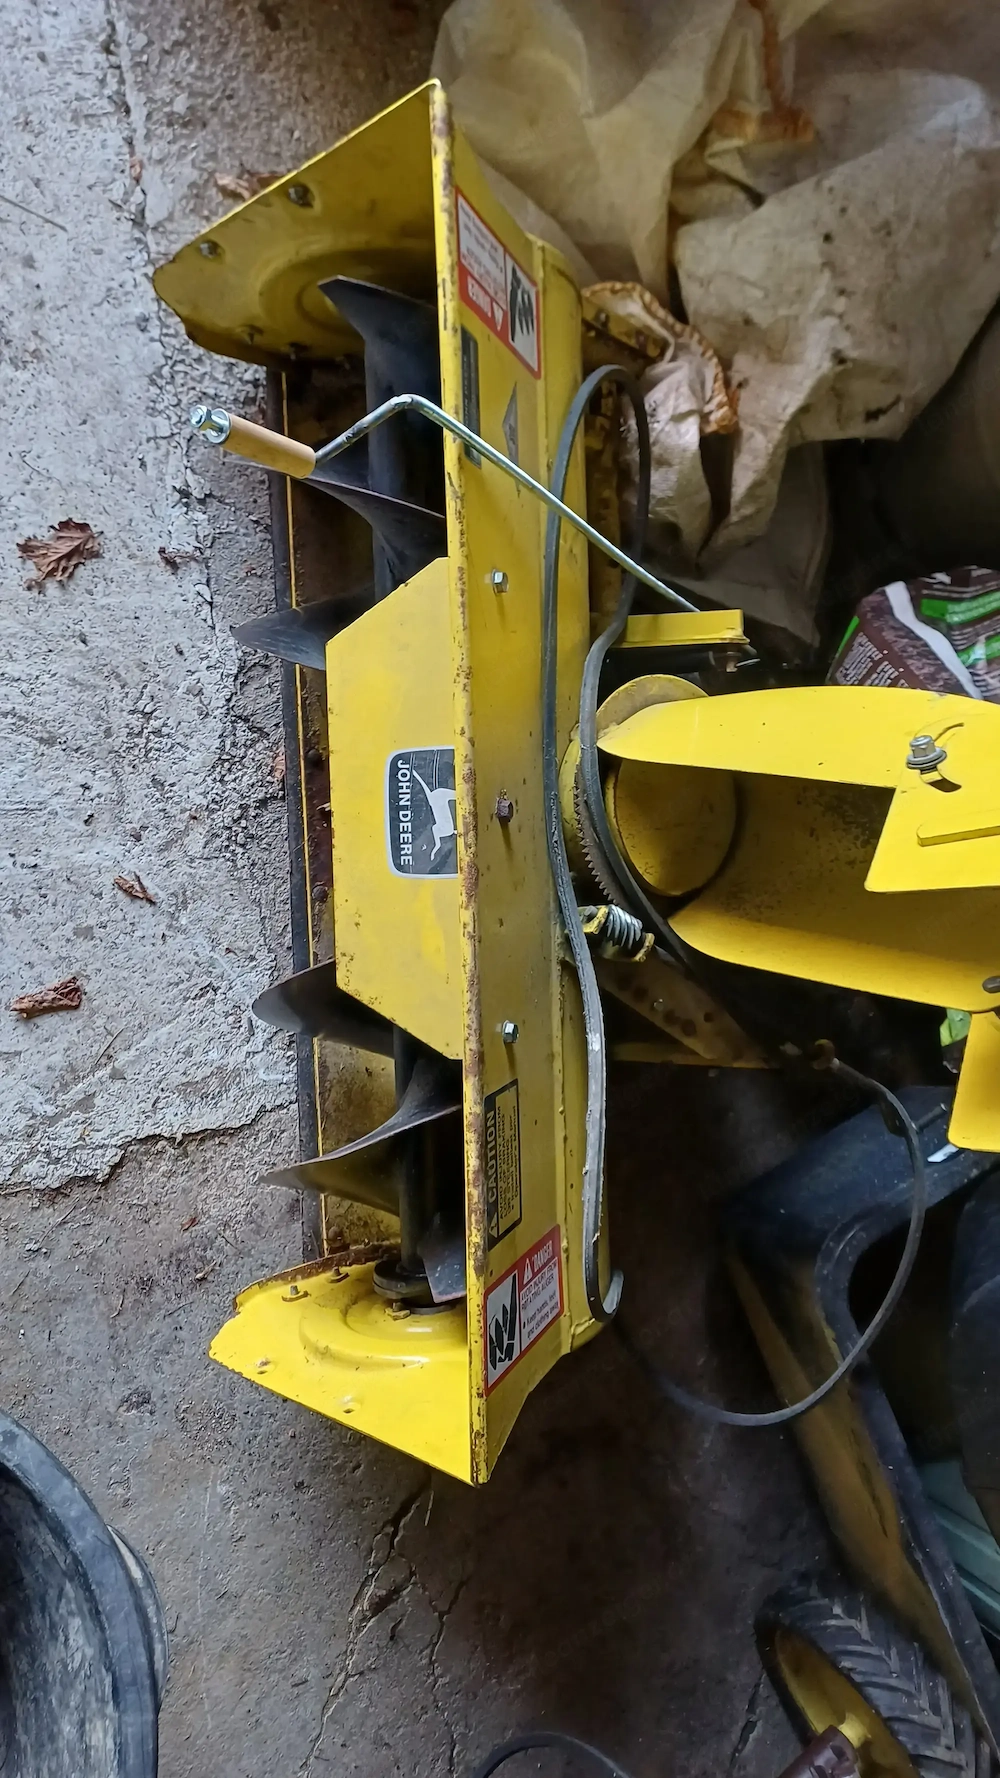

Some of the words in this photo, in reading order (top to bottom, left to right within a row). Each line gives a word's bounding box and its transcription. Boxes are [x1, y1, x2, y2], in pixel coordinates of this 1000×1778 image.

[397, 760, 411, 806] JOHN
[399, 810, 413, 866] DEERE
[486, 1110, 497, 1203] CAUTION
